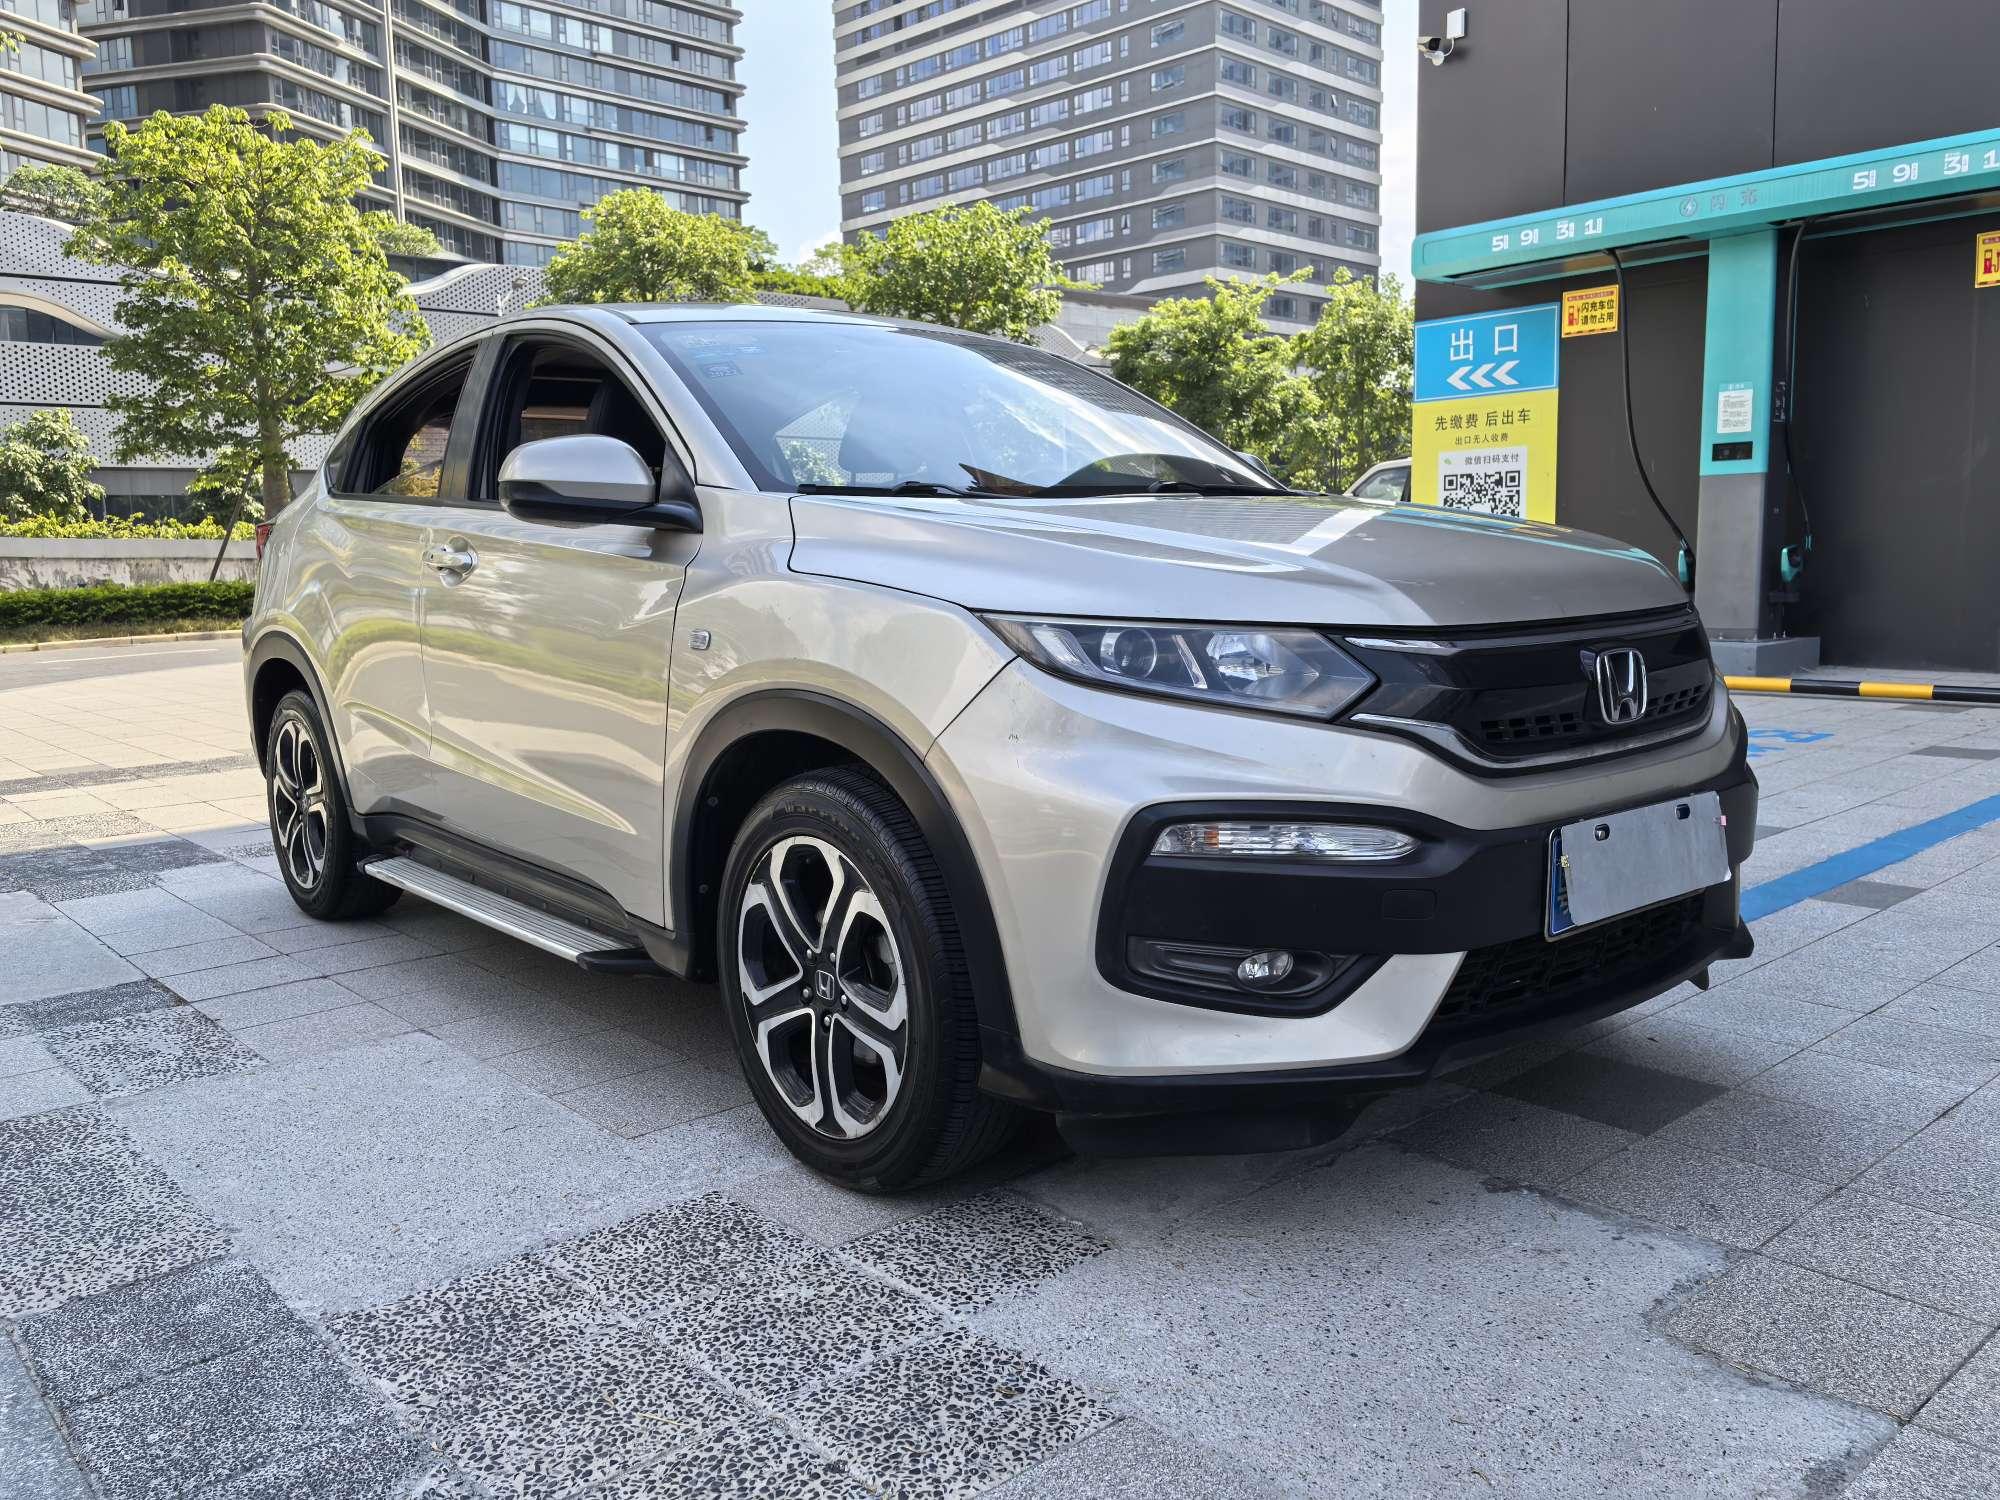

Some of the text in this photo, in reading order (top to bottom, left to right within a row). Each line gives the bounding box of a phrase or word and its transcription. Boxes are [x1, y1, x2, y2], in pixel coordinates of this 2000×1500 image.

[1581, 299, 1614, 312] 闪充车位
[1581, 312, 1614, 325] 请勿占用
[1450, 323, 1519, 362] 出口
[1434, 408, 1531, 432] 先缴费 后出车
[1455, 432, 1509, 445] 出口无人收费
[1464, 453, 1519, 466] 微信扫码支付
